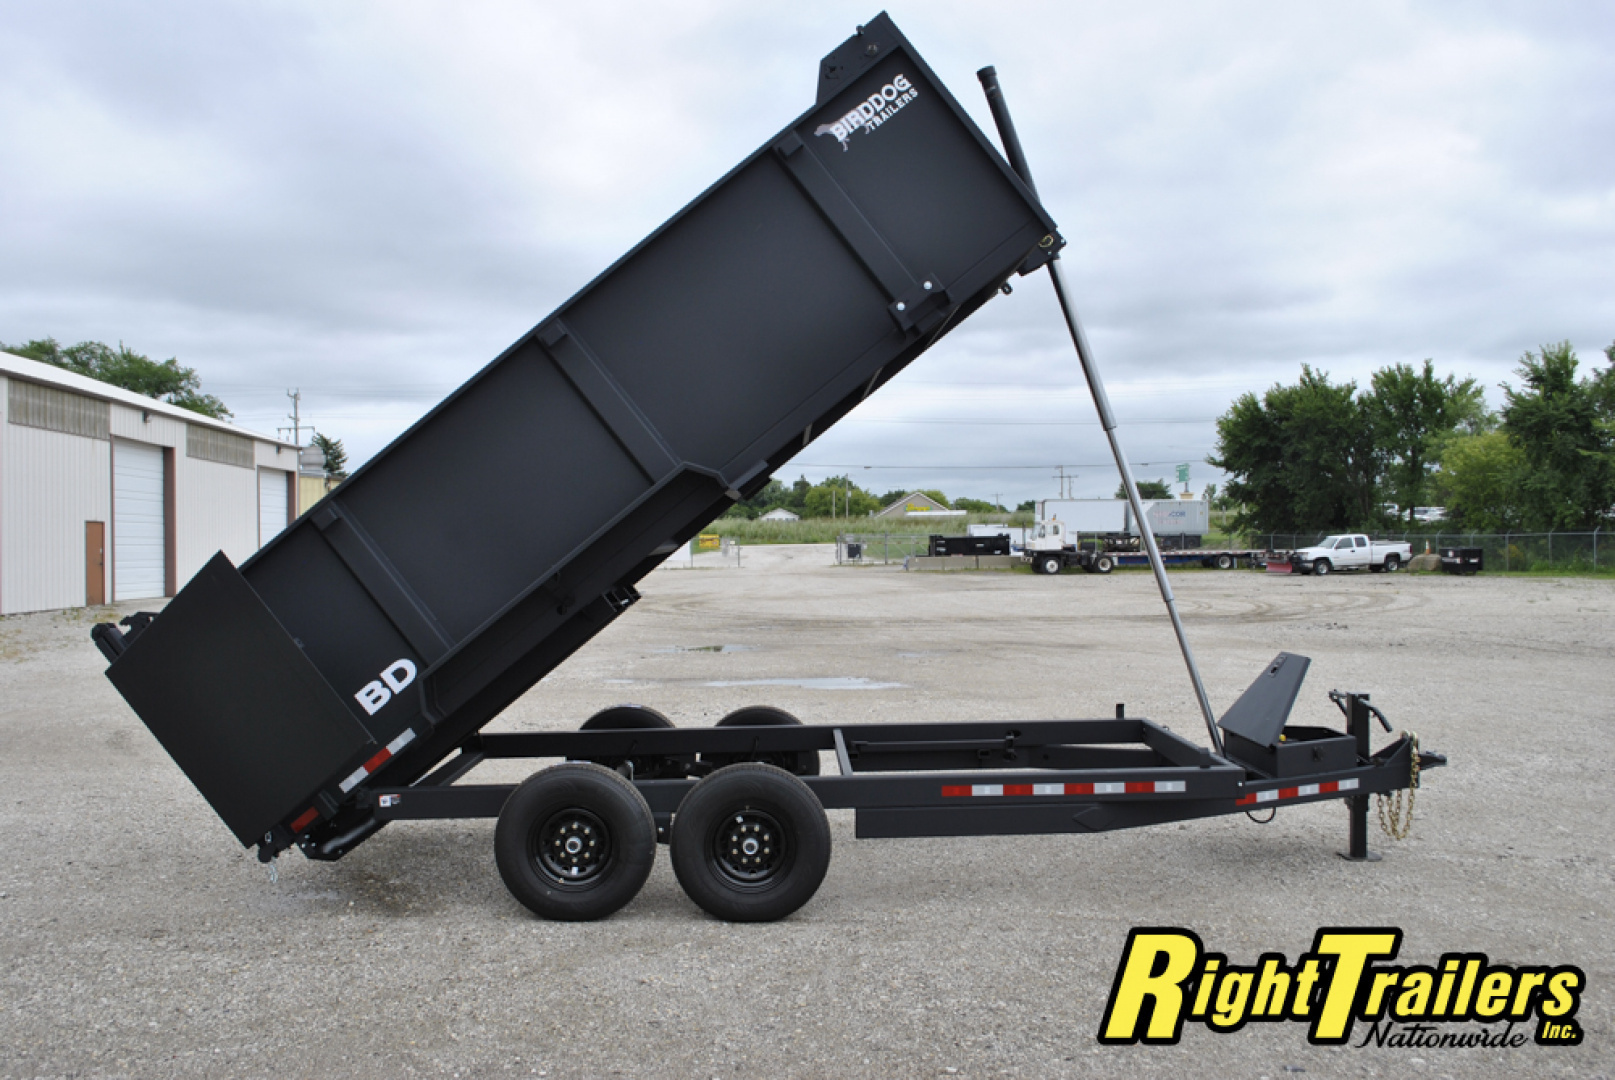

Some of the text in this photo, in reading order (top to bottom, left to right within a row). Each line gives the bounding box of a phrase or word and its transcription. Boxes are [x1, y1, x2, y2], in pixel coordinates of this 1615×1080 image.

[830, 73, 912, 142] BIRDDOG
[866, 87, 919, 130] TRAILERS
[353, 658, 418, 716] BD
